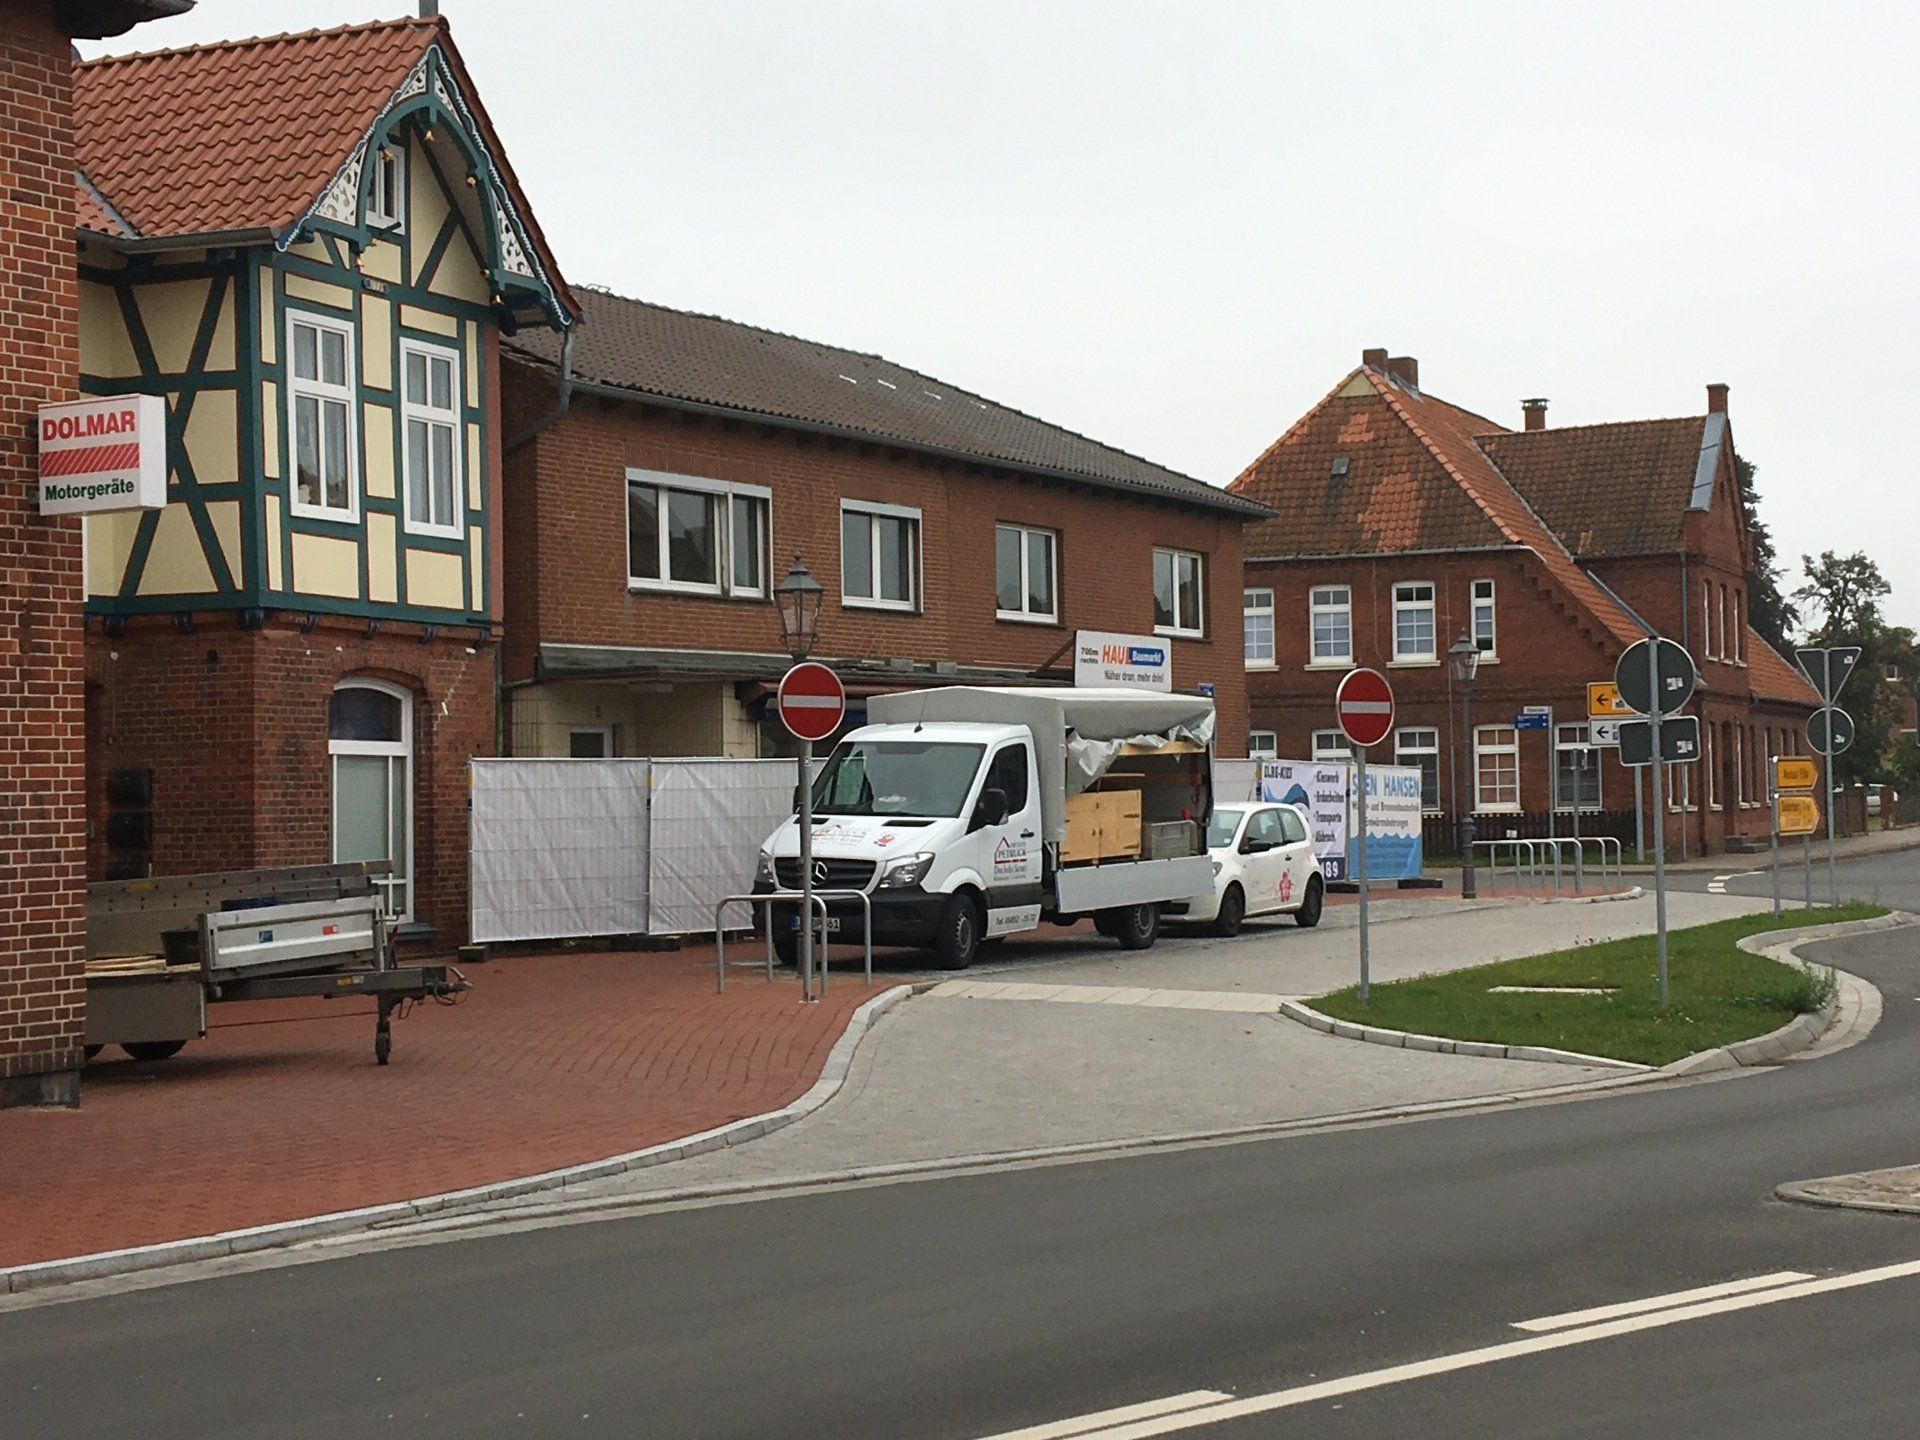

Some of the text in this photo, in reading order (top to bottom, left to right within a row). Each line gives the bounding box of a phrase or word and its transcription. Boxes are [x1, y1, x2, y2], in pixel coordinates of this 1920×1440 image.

[43, 410, 135, 441] DOLMAR
[45, 478, 135, 501] Motorgeräte
[1264, 765, 1293, 779] ELBE-KIES
[1316, 770, 1339, 783] Kieswerk
[1352, 774, 1420, 798] SEN HANSEN
[1316, 790, 1344, 803] Erdarbeiten
[1316, 811, 1342, 826] Transporte
